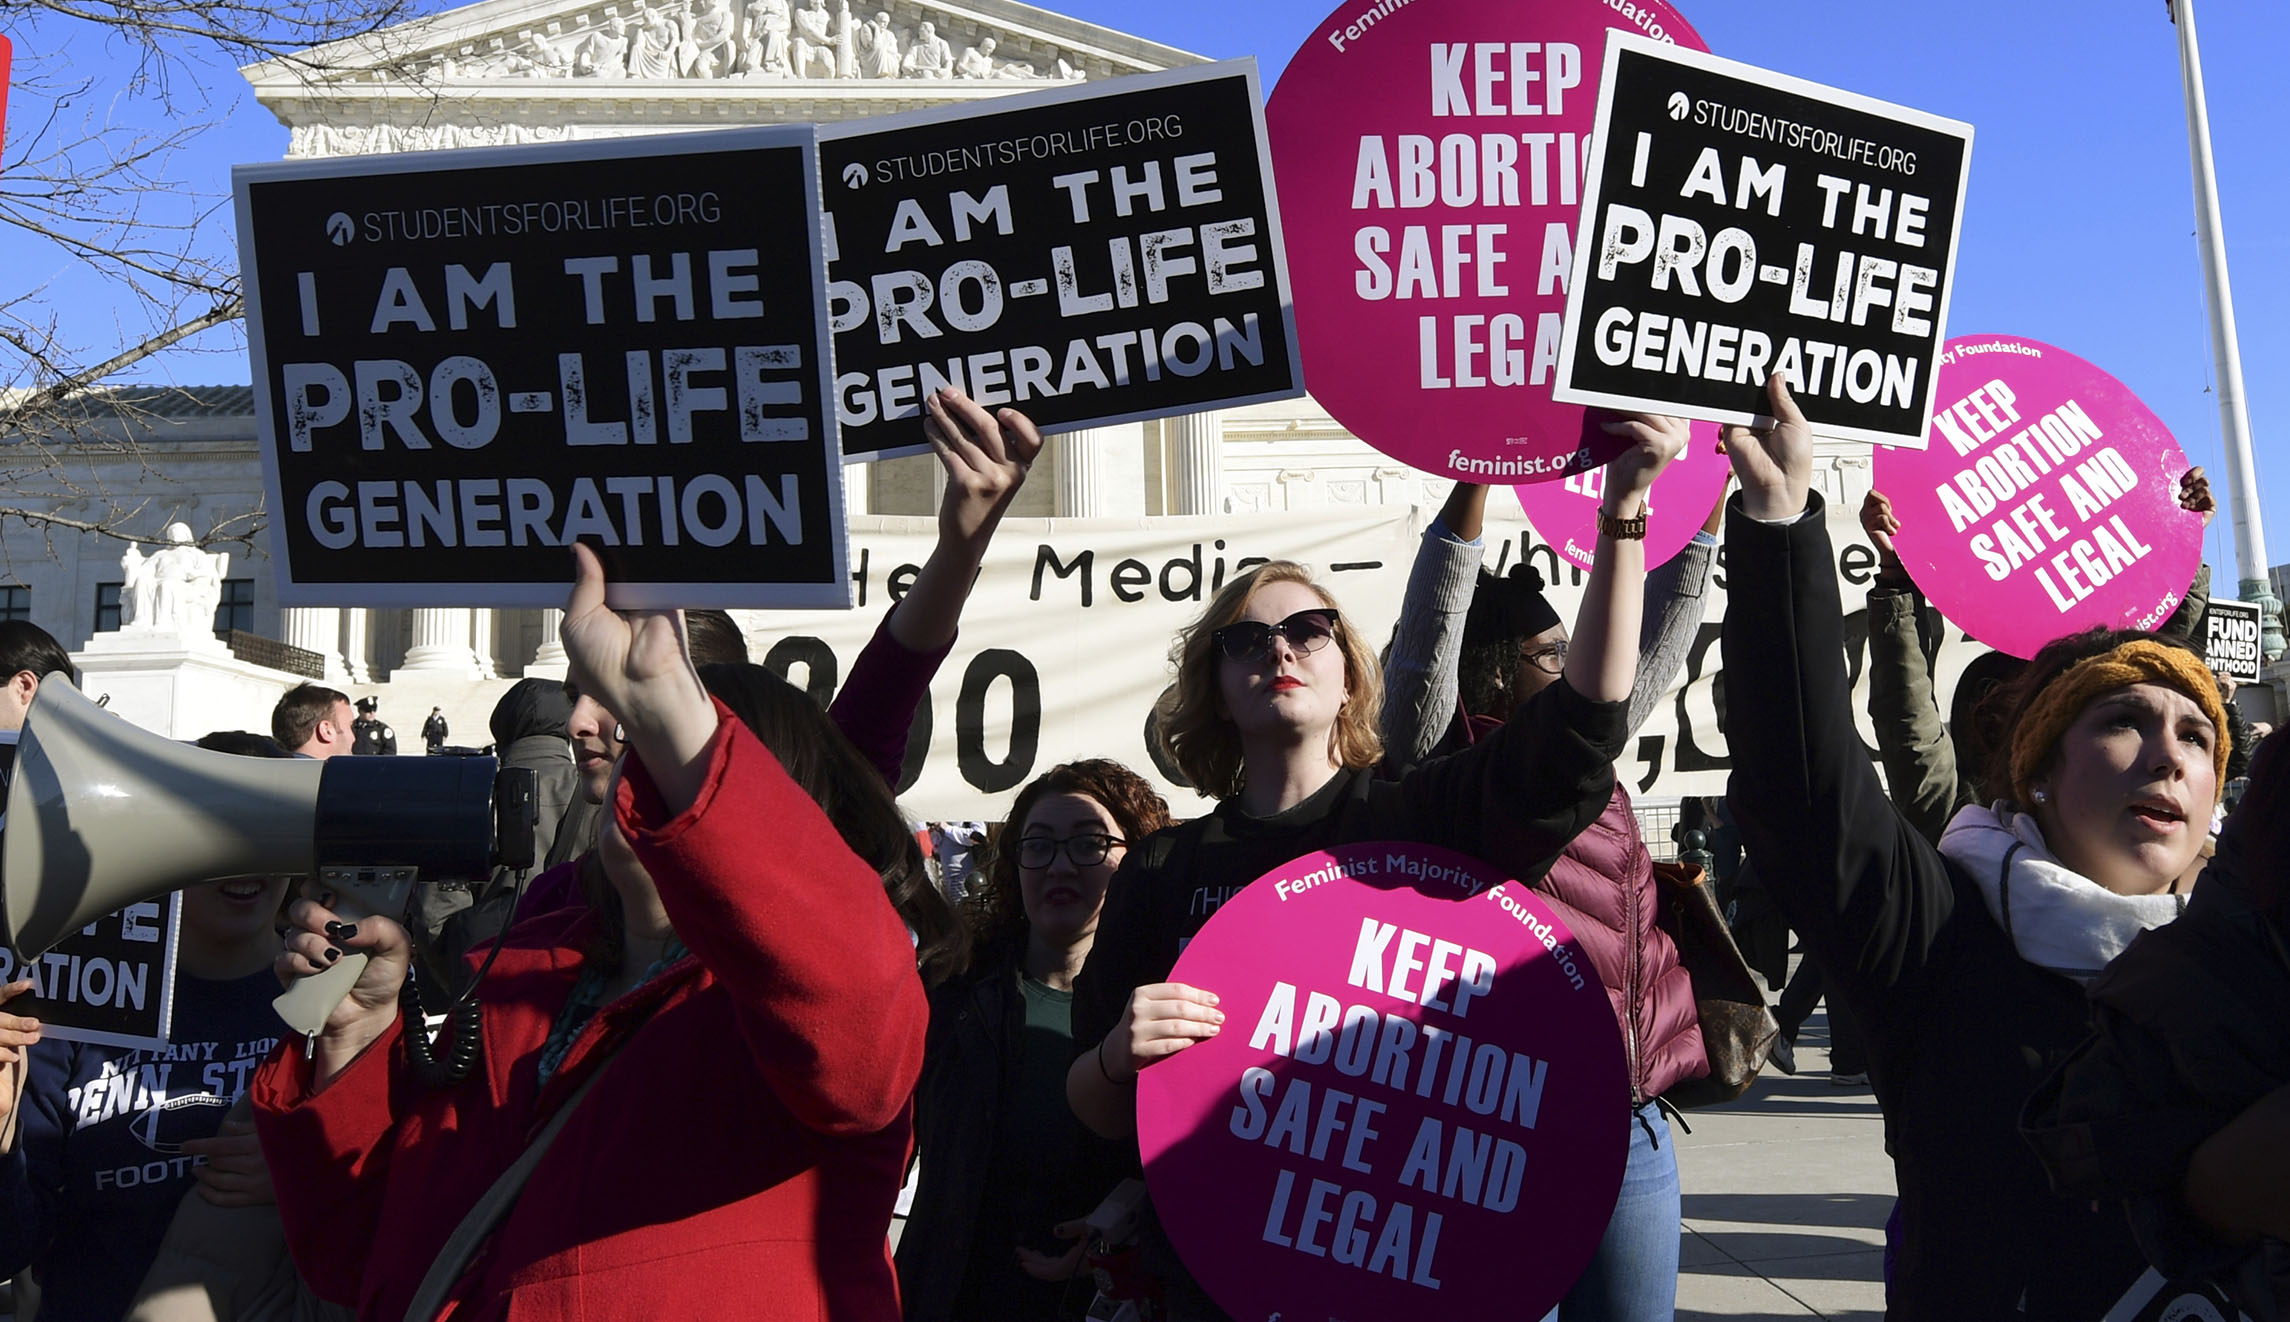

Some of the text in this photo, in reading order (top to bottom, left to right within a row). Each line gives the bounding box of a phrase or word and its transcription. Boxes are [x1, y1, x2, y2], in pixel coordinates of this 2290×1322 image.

[1430, 41, 1582, 117] KEEP
[876, 113, 1183, 184] STUDENTSFORLIFE.ORG
[1350, 132, 1592, 210] ABORTI
[1694, 98, 1917, 176] STUDENTSFORLIFE.ORG
[364, 191, 721, 242] STUDENTSFORLIFE.ORG
[884, 184, 1014, 253] AM
[1053, 151, 1222, 223] THE
[1630, 132, 1930, 248] I AM THE
[297, 247, 764, 336] I AM THE
[829, 216, 1265, 345] PRO-LIFE
[1353, 223, 1508, 301] SAFE
[1598, 202, 1939, 339] PRO-LIFE
[282, 344, 809, 453] PRO-LIFE
[837, 312, 1265, 427] GENERATION
[1593, 306, 1918, 410] GENERATION
[1955, 340, 2042, 358] Foundation
[1447, 447, 1593, 476] feminist.org
[1932, 378, 2022, 457] KEEP
[1935, 399, 2103, 534] ABORTION
[305, 473, 803, 550] GENERATION
[1969, 492, 2070, 581] SAFE
[2058, 446, 2139, 523] AND
[2034, 514, 2152, 613] LEGAL
[2208, 616, 2257, 641] FUND
[1274, 854, 1586, 991] Feminist Majority Foundation
[1347, 916, 1497, 1019] KEEP
[201, 1058, 261, 1106] ST
[1248, 981, 1549, 1131] ABORTION
[1229, 1066, 1527, 1214] SAFE AND
[1262, 1169, 1443, 1290] LEGAL
